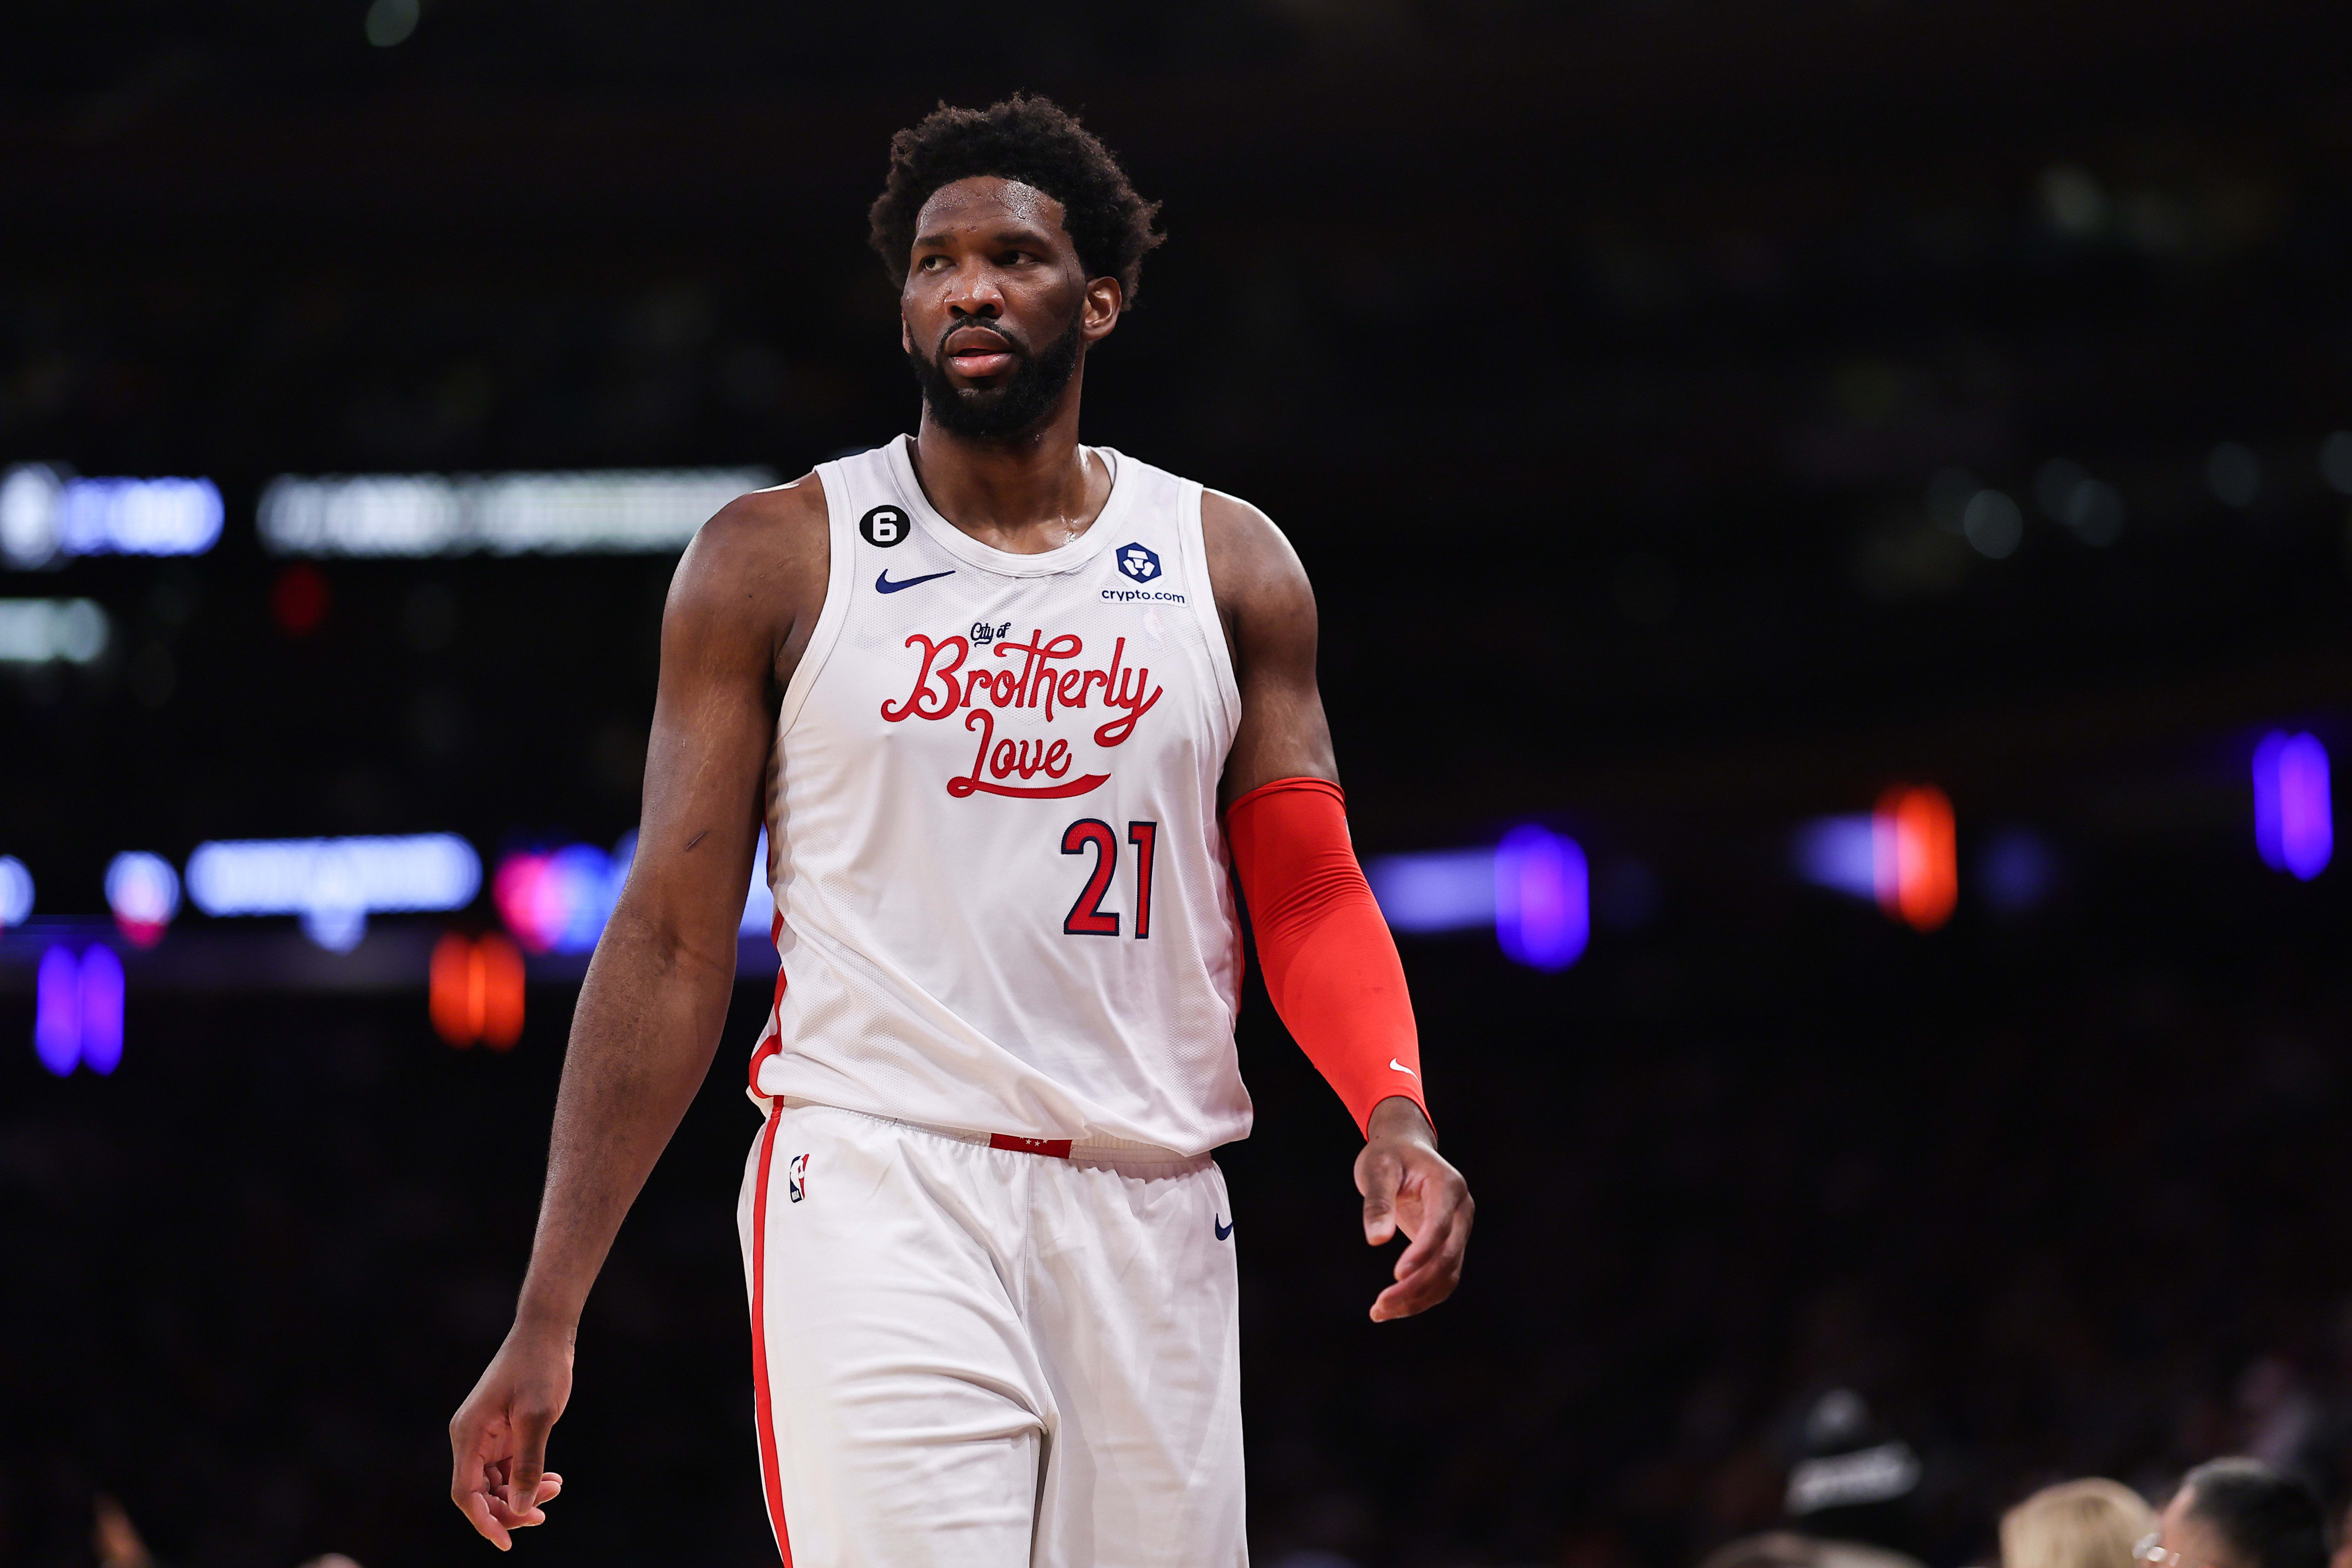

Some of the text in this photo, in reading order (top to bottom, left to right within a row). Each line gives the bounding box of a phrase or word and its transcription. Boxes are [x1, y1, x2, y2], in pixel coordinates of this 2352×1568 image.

[873, 511, 897, 541] 6
[1102, 590, 1185, 603] crypto.com
[970, 622, 1011, 647] City of
[881, 629, 1163, 747] Brotherly
[947, 709, 1111, 798] Love
[1061, 818, 1157, 939] 21
[791, 1190, 800, 1201] NBA
